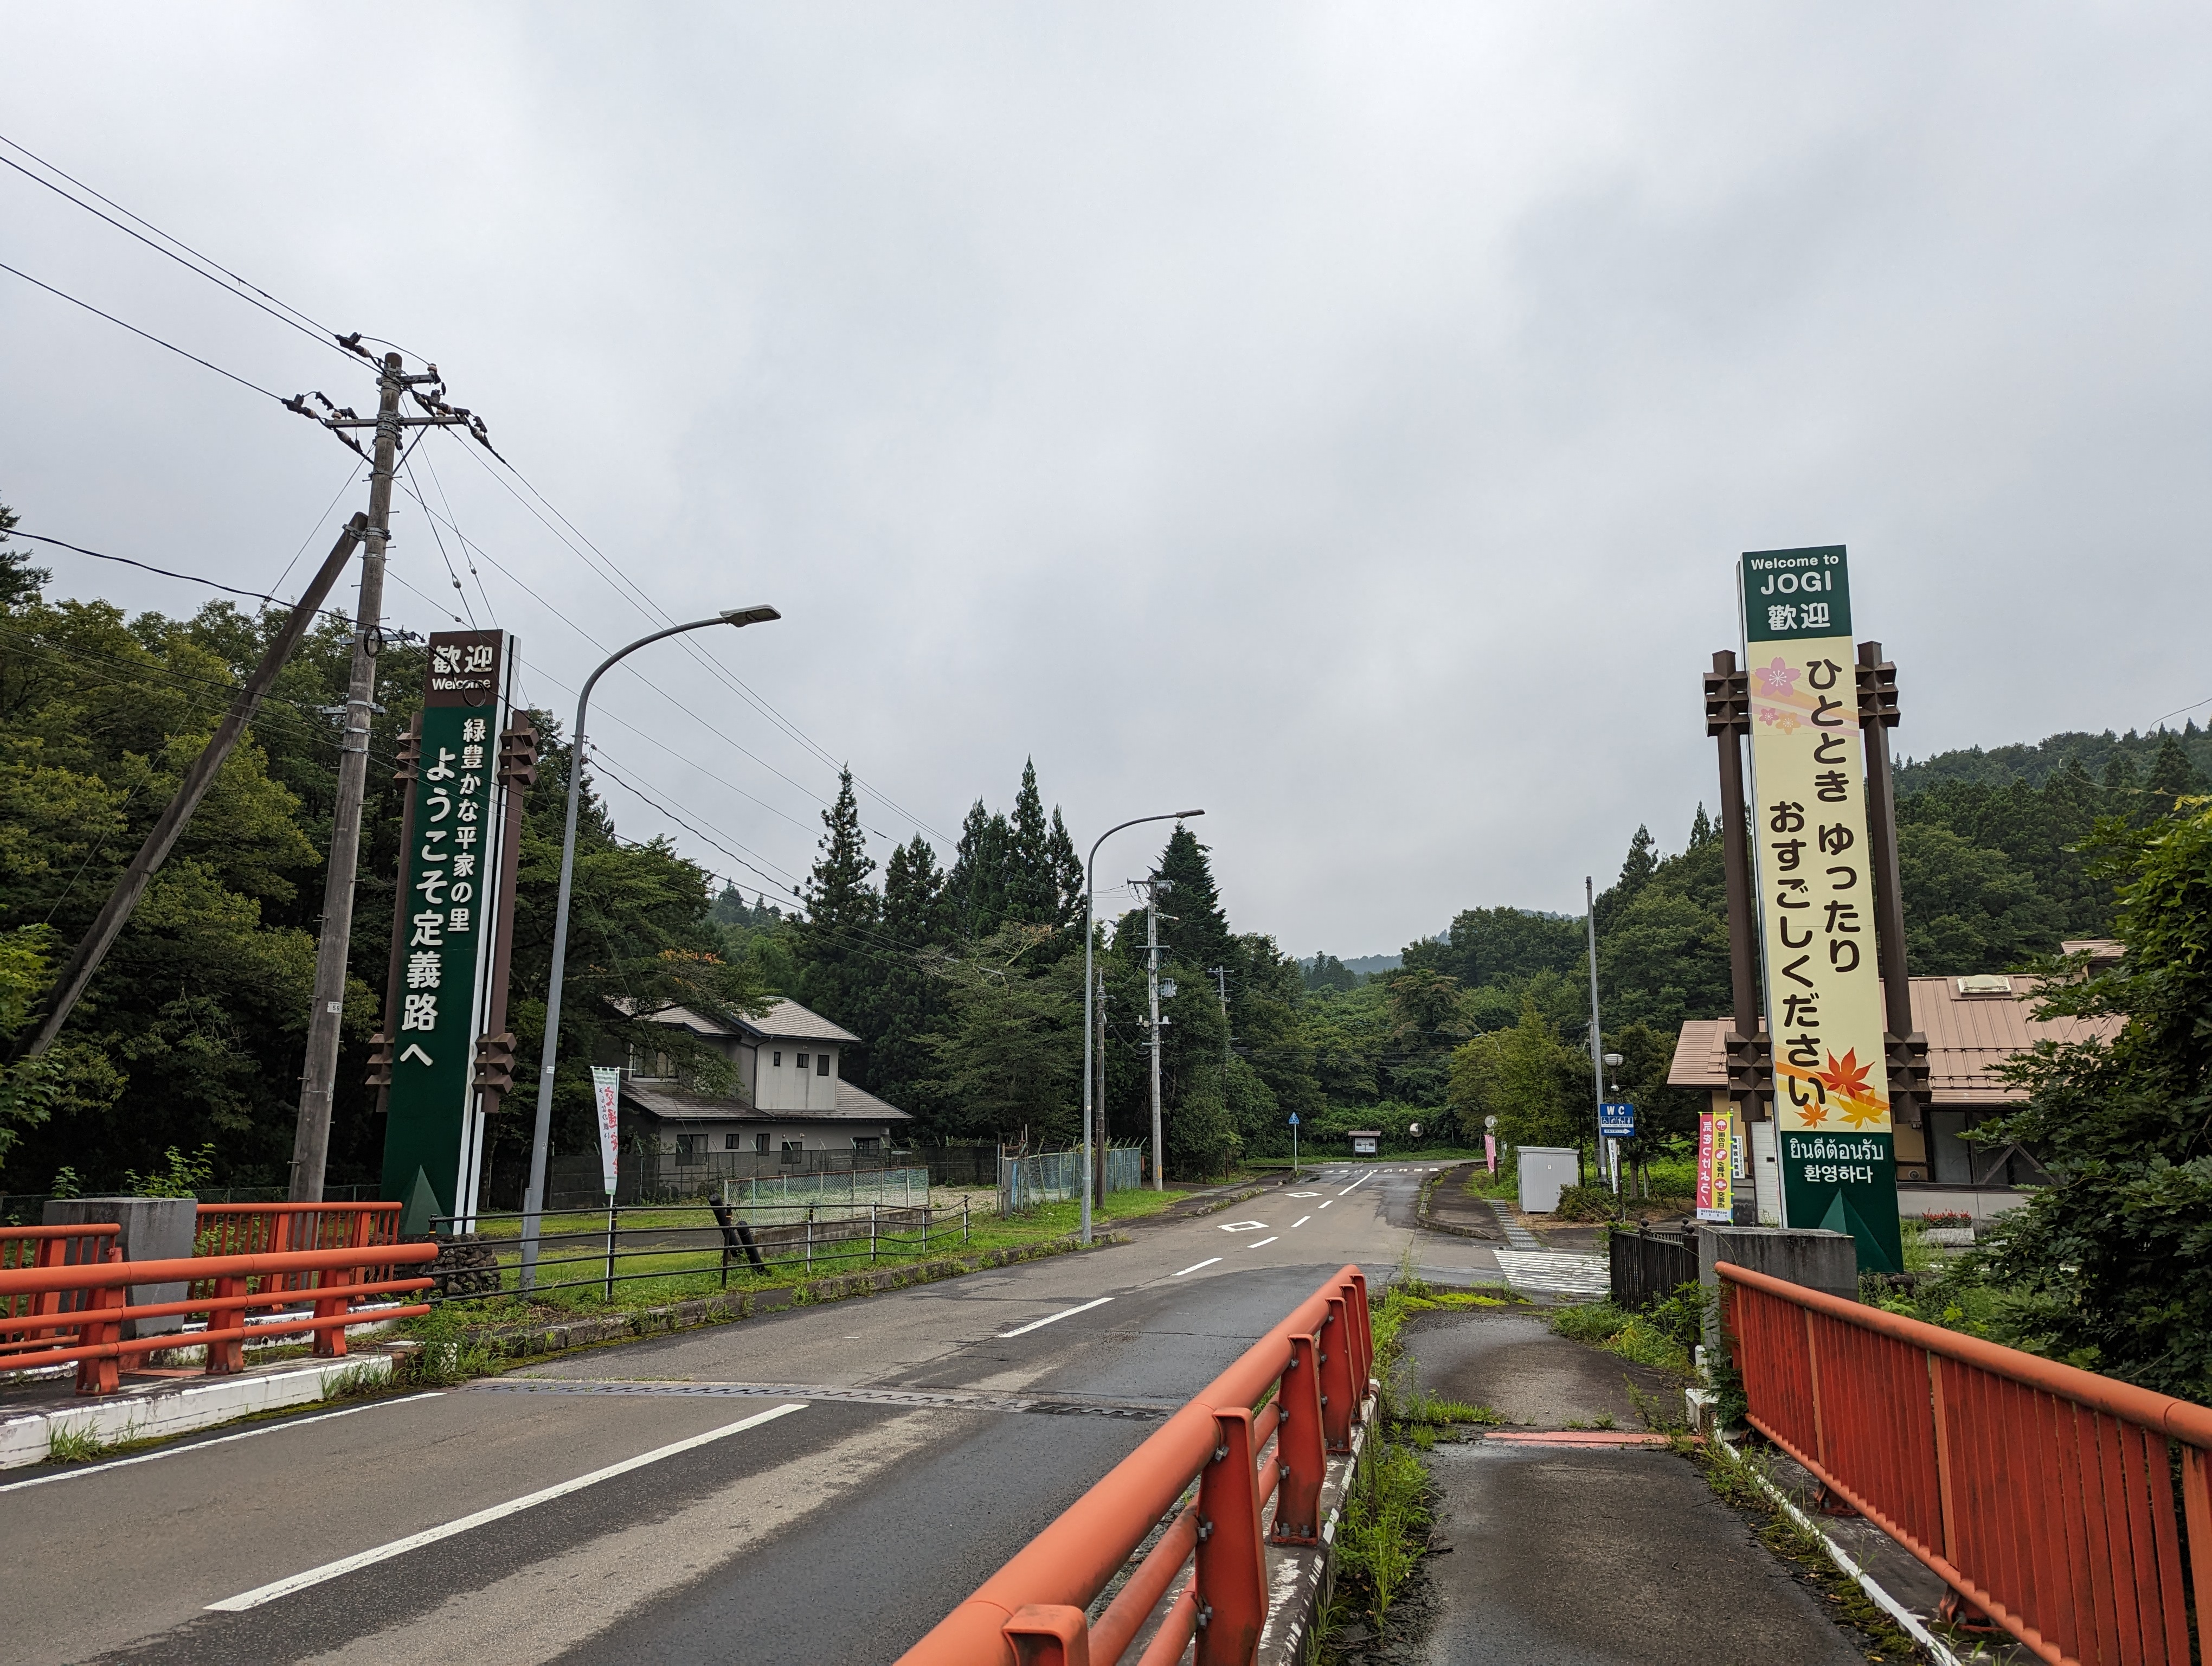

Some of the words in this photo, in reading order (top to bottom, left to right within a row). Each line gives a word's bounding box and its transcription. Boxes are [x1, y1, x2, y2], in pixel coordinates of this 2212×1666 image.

[1751, 557, 1818, 570] Welcome
[1823, 554, 1839, 565] to
[1760, 571, 1831, 595] JOGI
[1767, 603, 1830, 631] 歡迎
[433, 645, 492, 674] 歓迎
[432, 678, 491, 690] Welcome
[1806, 659, 1849, 803] ひととき
[448, 718, 486, 932] 緑豊かな平家の里
[400, 747, 456, 1067] ようこそ定義路へ
[1819, 823, 1860, 973] ゆったり
[1770, 801, 1826, 1107] おすごしください
[1607, 1106, 1624, 1115] WC
[1790, 1137, 1883, 1160] ยินดีต้อนรับ
[1804, 1164, 1873, 1183] 환영하다
